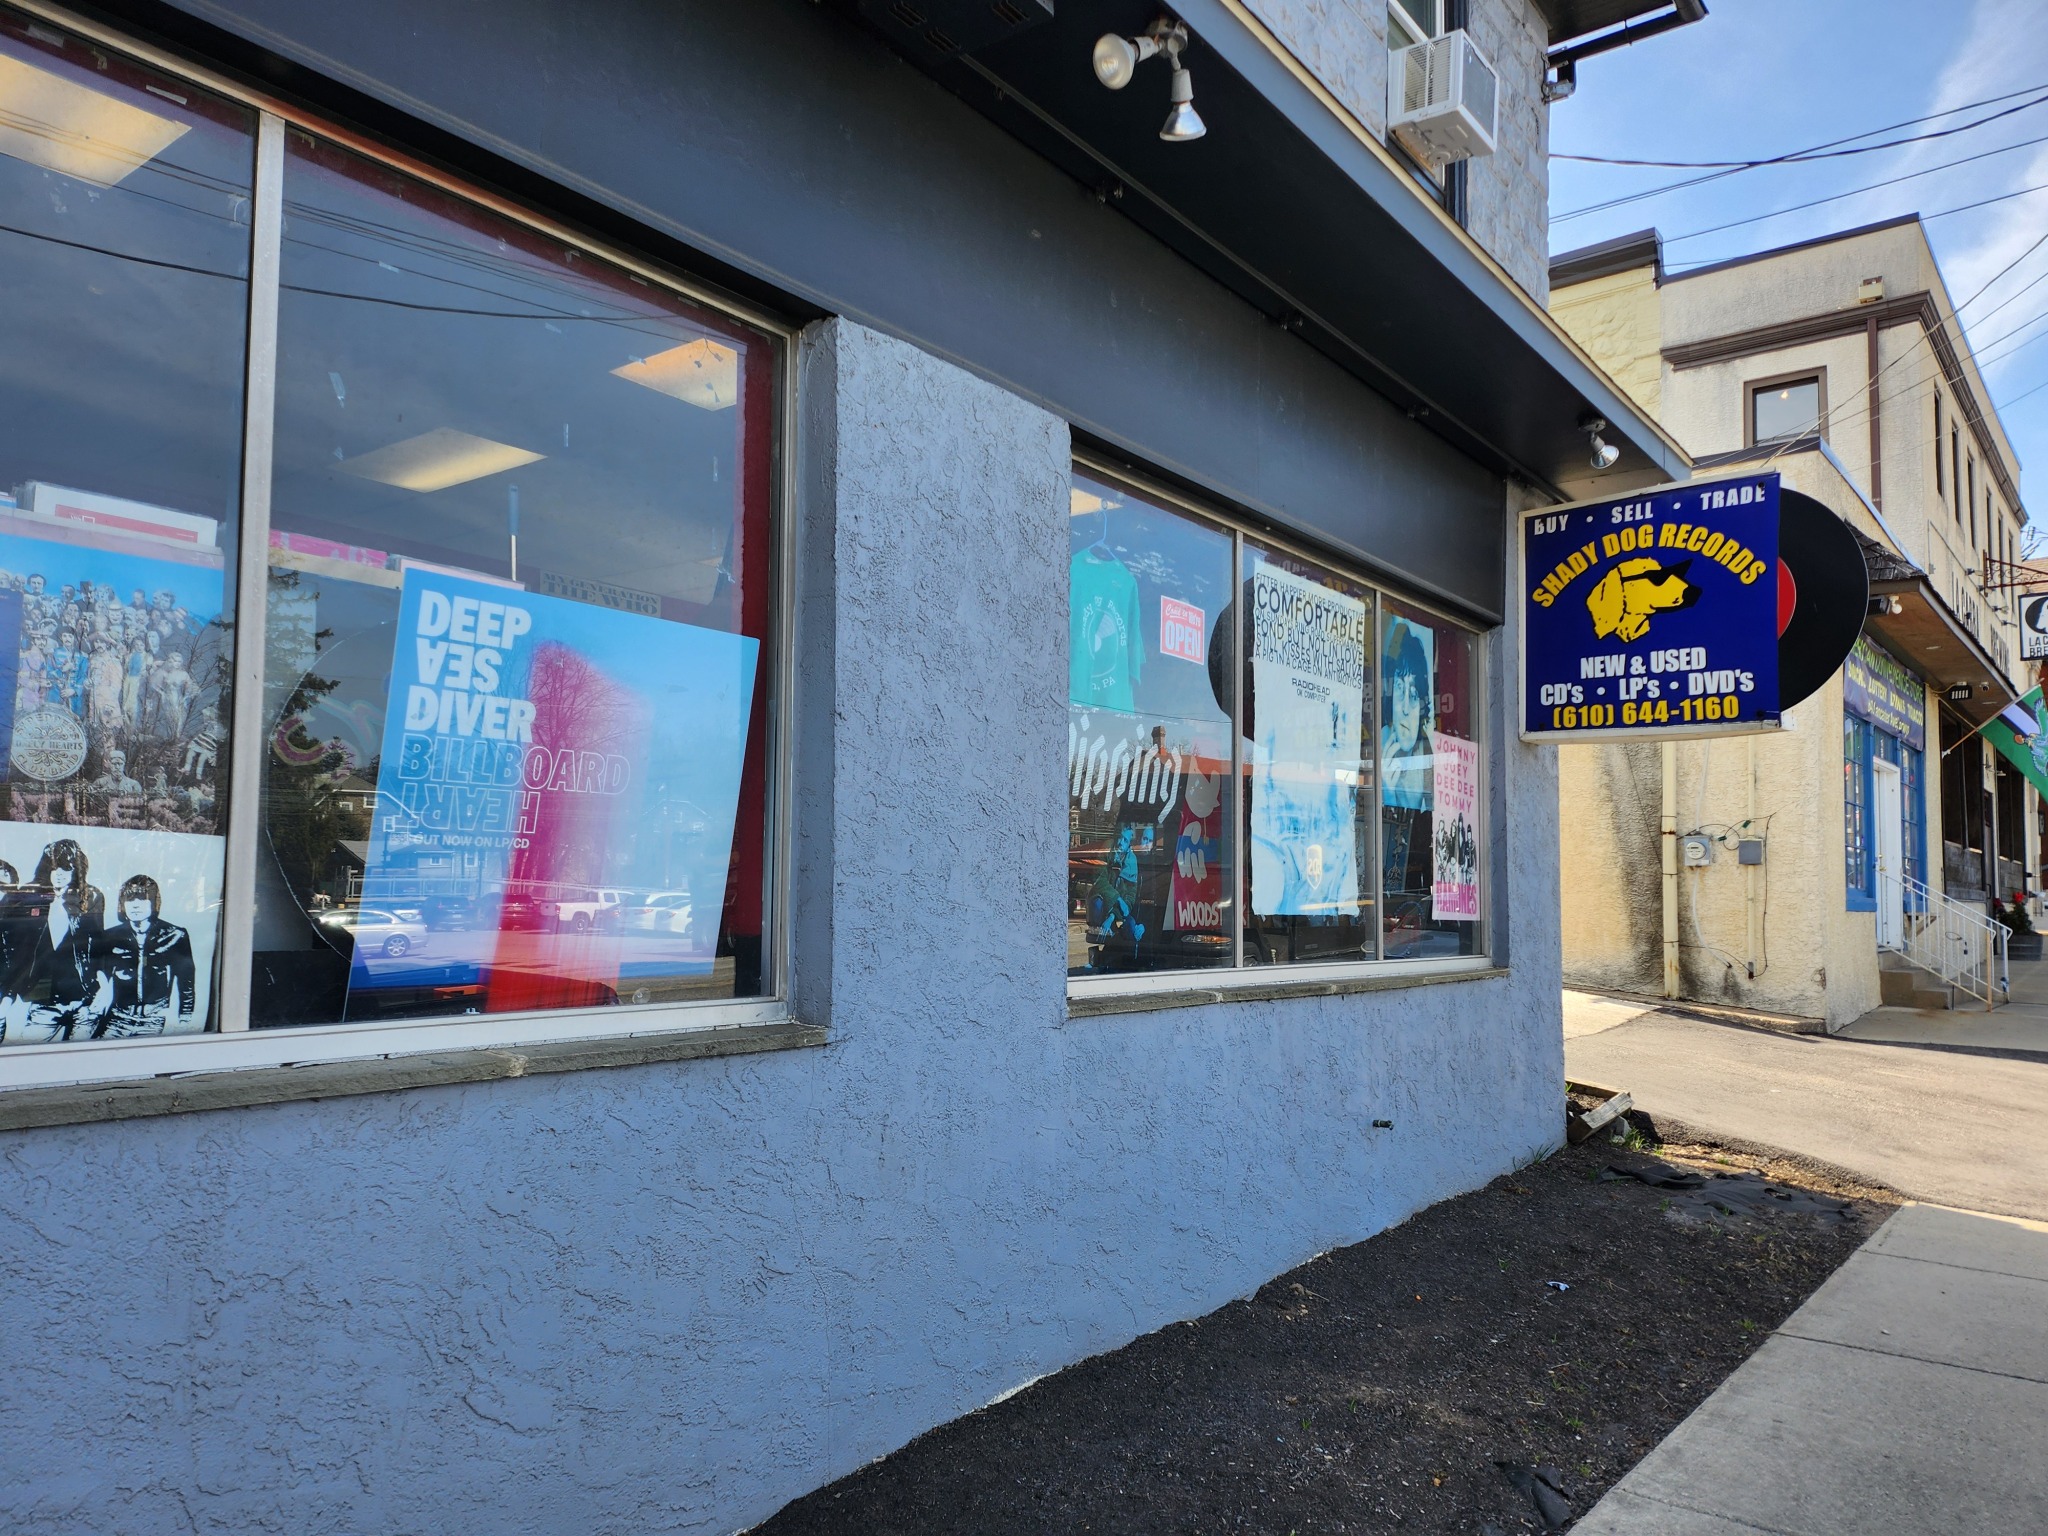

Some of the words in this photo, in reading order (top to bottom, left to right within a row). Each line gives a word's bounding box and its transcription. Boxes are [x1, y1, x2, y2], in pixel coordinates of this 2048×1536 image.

[1534, 514, 1569, 535] BUY
[1611, 502, 1653, 523] SELL
[1700, 486, 1766, 510] TRADE
[1532, 541, 1599, 608] SHADY
[1603, 524, 1654, 558] DOG
[1658, 523, 1767, 585] RECORDS
[544, 581, 596, 602] THE
[601, 593, 658, 615] WHO
[570, 579, 658, 604] GENERATION
[1256, 572, 1278, 591] FITTER
[1280, 581, 1307, 600] HAPPIER
[1308, 593, 1326, 608] MORE
[1328, 600, 1365, 621] PRODUCTIVE
[416, 589, 532, 651] DEEP
[1257, 583, 1364, 644] COMFORTABLE
[1165, 620, 1201, 659] OPEN
[1255, 632, 1278, 653] STILL
[1282, 641, 1311, 664] KISSES
[1313, 650, 1334, 671] WITH
[1336, 658, 1363, 680] SALIVA
[1256, 616, 1284, 640] FOND
[1288, 627, 1305, 649] BUT
[1340, 643, 1364, 665] LOVE
[2029, 637, 2041, 647] LA
[416, 637, 503, 693] SEA
[1262, 649, 1275, 662] PIG
[1292, 658, 1312, 674] CAGE
[1313, 664, 1323, 677] ON
[1580, 654, 1627, 679] NEW
[1630, 654, 1646, 675] &
[1650, 647, 1707, 673] USED
[1102, 676, 1116, 689] PA
[1291, 677, 1331, 696] RADIOHEAD
[1296, 688, 1303, 697] OK
[1304, 690, 1326, 703] COMPUTER
[1540, 683, 1584, 706] CD's
[1619, 677, 1661, 701] LP's
[1688, 670, 1755, 697] DVD's
[404, 684, 537, 743] DIVER
[1553, 705, 1614, 728] (610)
[1622, 695, 1740, 725] 644-1160
[49, 740, 84, 750] HEARTS
[1436, 738, 1476, 765] JOHNNY
[398, 733, 632, 795] BILLBOARD
[1443, 760, 1468, 779] JOEY
[1437, 773, 1455, 791] DEE
[1457, 780, 1475, 798] DEE
[1438, 790, 1472, 814] TOMMY
[400, 782, 540, 835] HEART
[415, 834, 440, 846] OUT
[442, 835, 473, 847] NOW
[474, 836, 493, 848] ON
[494, 837, 530, 850] LP/CD
[1436, 881, 1478, 915] RAMONES
